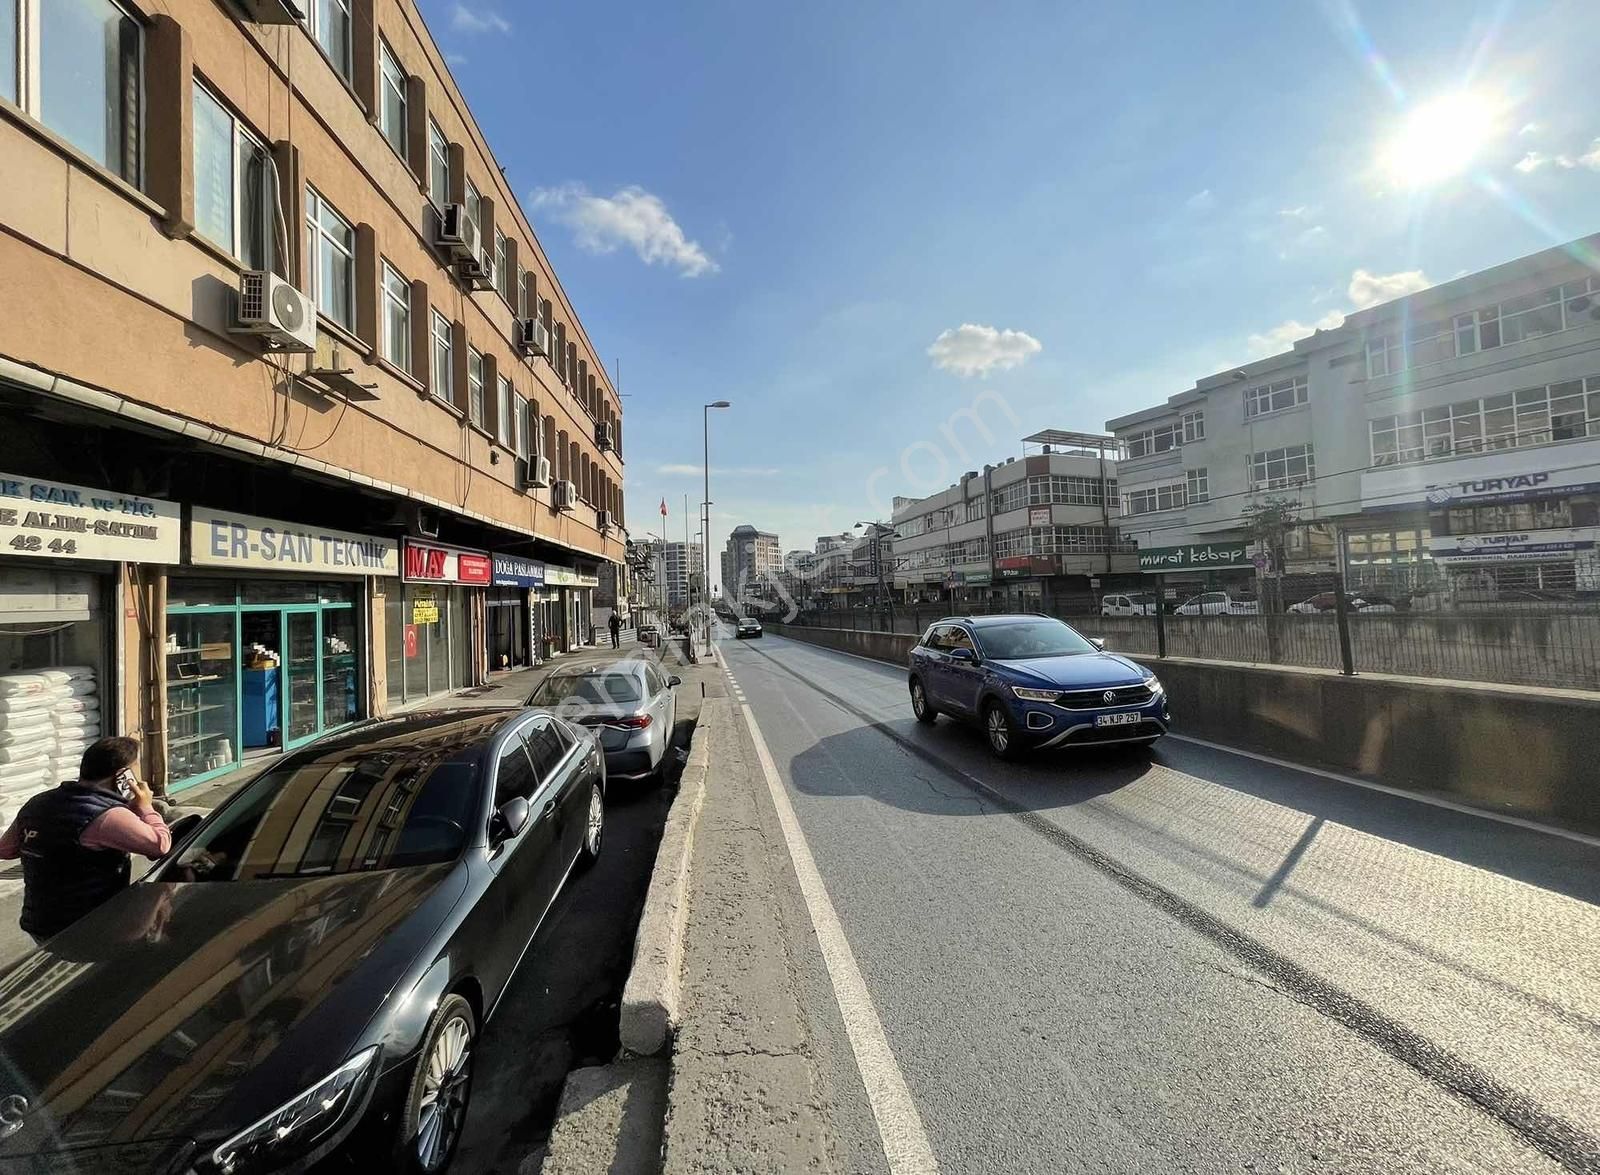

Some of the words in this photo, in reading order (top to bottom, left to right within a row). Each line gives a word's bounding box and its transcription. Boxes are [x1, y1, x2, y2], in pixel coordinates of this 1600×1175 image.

[1458, 472, 1549, 494] TURYAP
[30, 484, 85, 507] SAN.
[91, 498, 114, 512] ve
[119, 497, 157, 518] TİC.
[22, 511, 158, 540] ALIM-SATIM
[9, 535, 42, 551] 42
[48, 538, 77, 554] 44
[210, 519, 313, 563] ER-SAN
[320, 538, 388, 569] TEKNİK
[1481, 534, 1529, 545] TURYAP
[406, 546, 448, 578] MAY
[1140, 548, 1185, 566] murat
[1190, 546, 1242, 563] kebap
[1098, 715, 1108, 726] 34
[1110, 714, 1124, 725] NJP
[1126, 713, 1138, 723] 297
